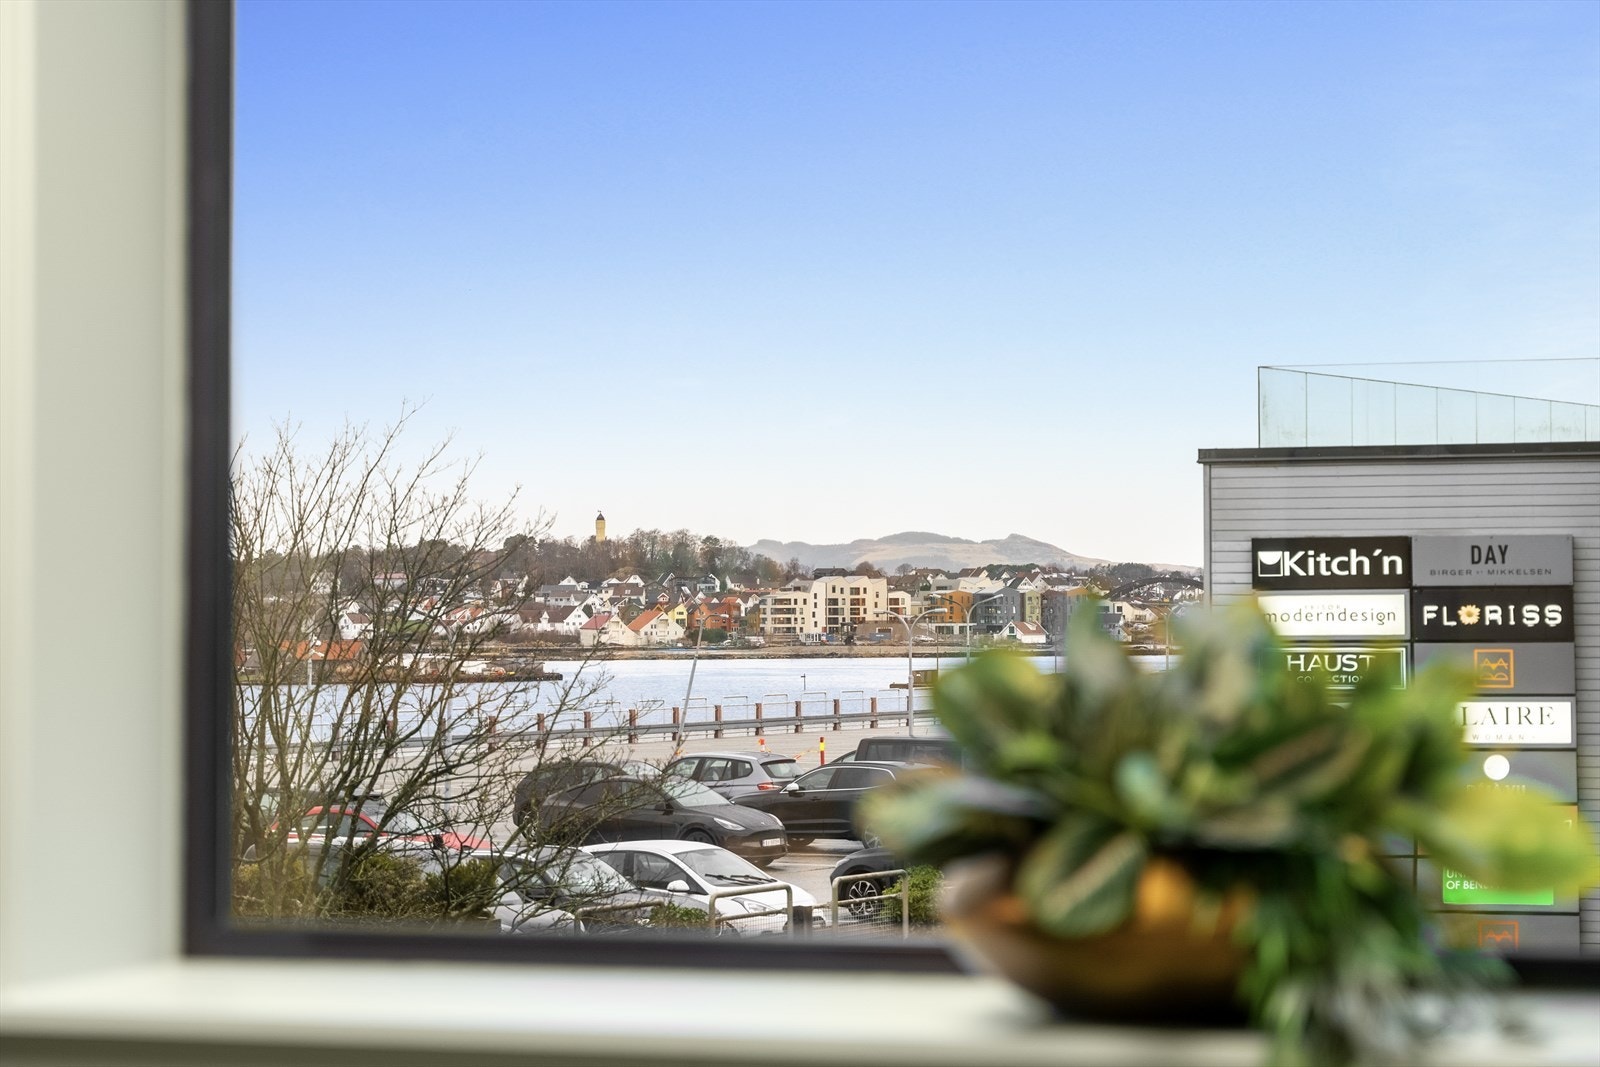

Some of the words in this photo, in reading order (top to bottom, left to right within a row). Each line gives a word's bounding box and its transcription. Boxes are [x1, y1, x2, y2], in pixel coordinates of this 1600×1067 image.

[1471, 545, 1508, 565] DAY
[1264, 608, 1396, 625] moderndesign
[1286, 654, 1375, 672] HAUST
[1453, 706, 1555, 726] LAIRE
[1446, 880, 1460, 890] OF
